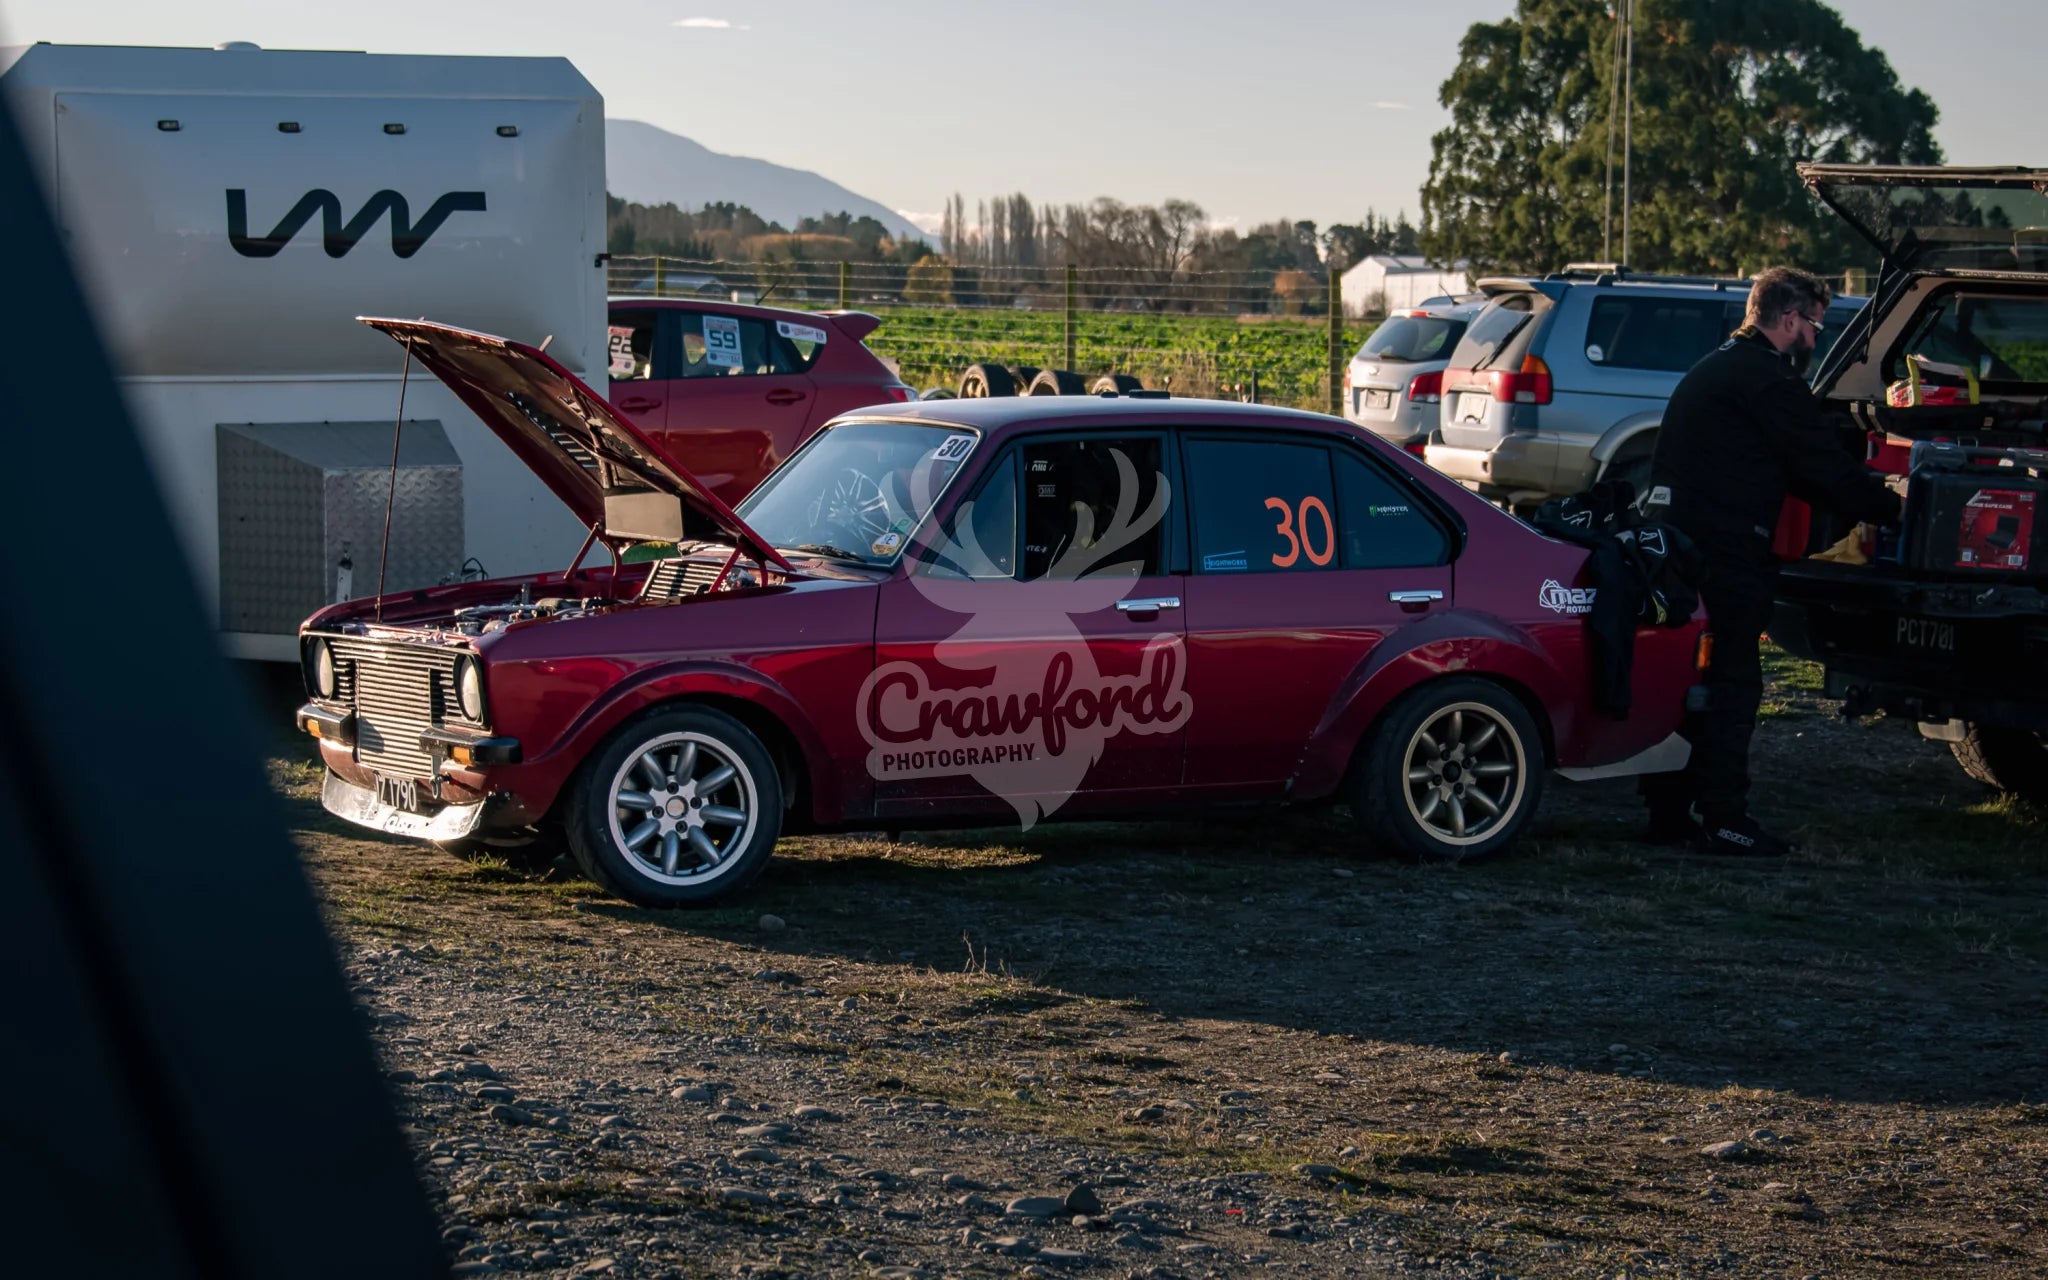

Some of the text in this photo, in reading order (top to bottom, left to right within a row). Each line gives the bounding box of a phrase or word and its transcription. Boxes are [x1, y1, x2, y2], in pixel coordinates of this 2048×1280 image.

[709, 329, 737, 349] 59
[938, 438, 971, 458] 30
[1264, 496, 1335, 568] 30
[1550, 588, 1597, 605] maz
[1567, 605, 1592, 613] ROTAR
[1897, 617, 1955, 650] PCT701
